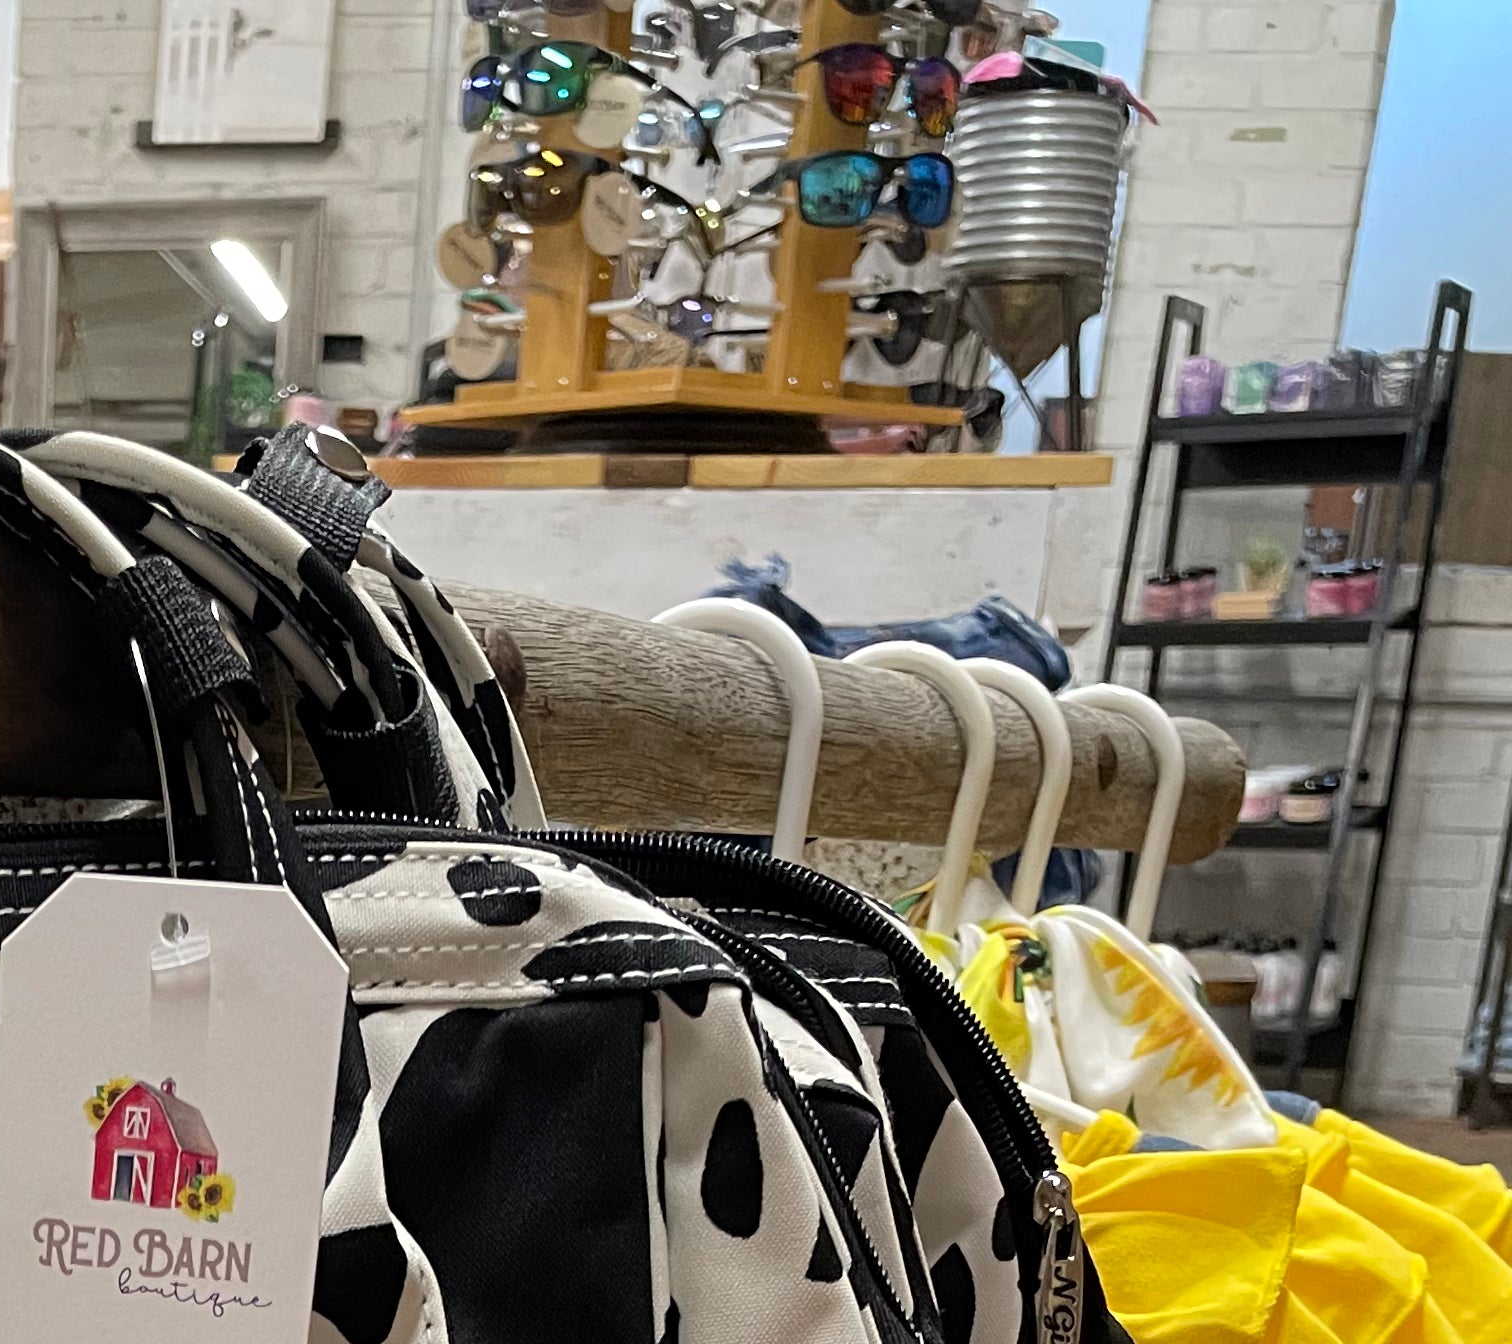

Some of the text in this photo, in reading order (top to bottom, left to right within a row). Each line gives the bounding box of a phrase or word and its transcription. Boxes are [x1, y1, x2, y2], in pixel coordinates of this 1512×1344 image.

[33, 1217, 252, 1283] RED BARN
[118, 1267, 273, 1318] boutique
